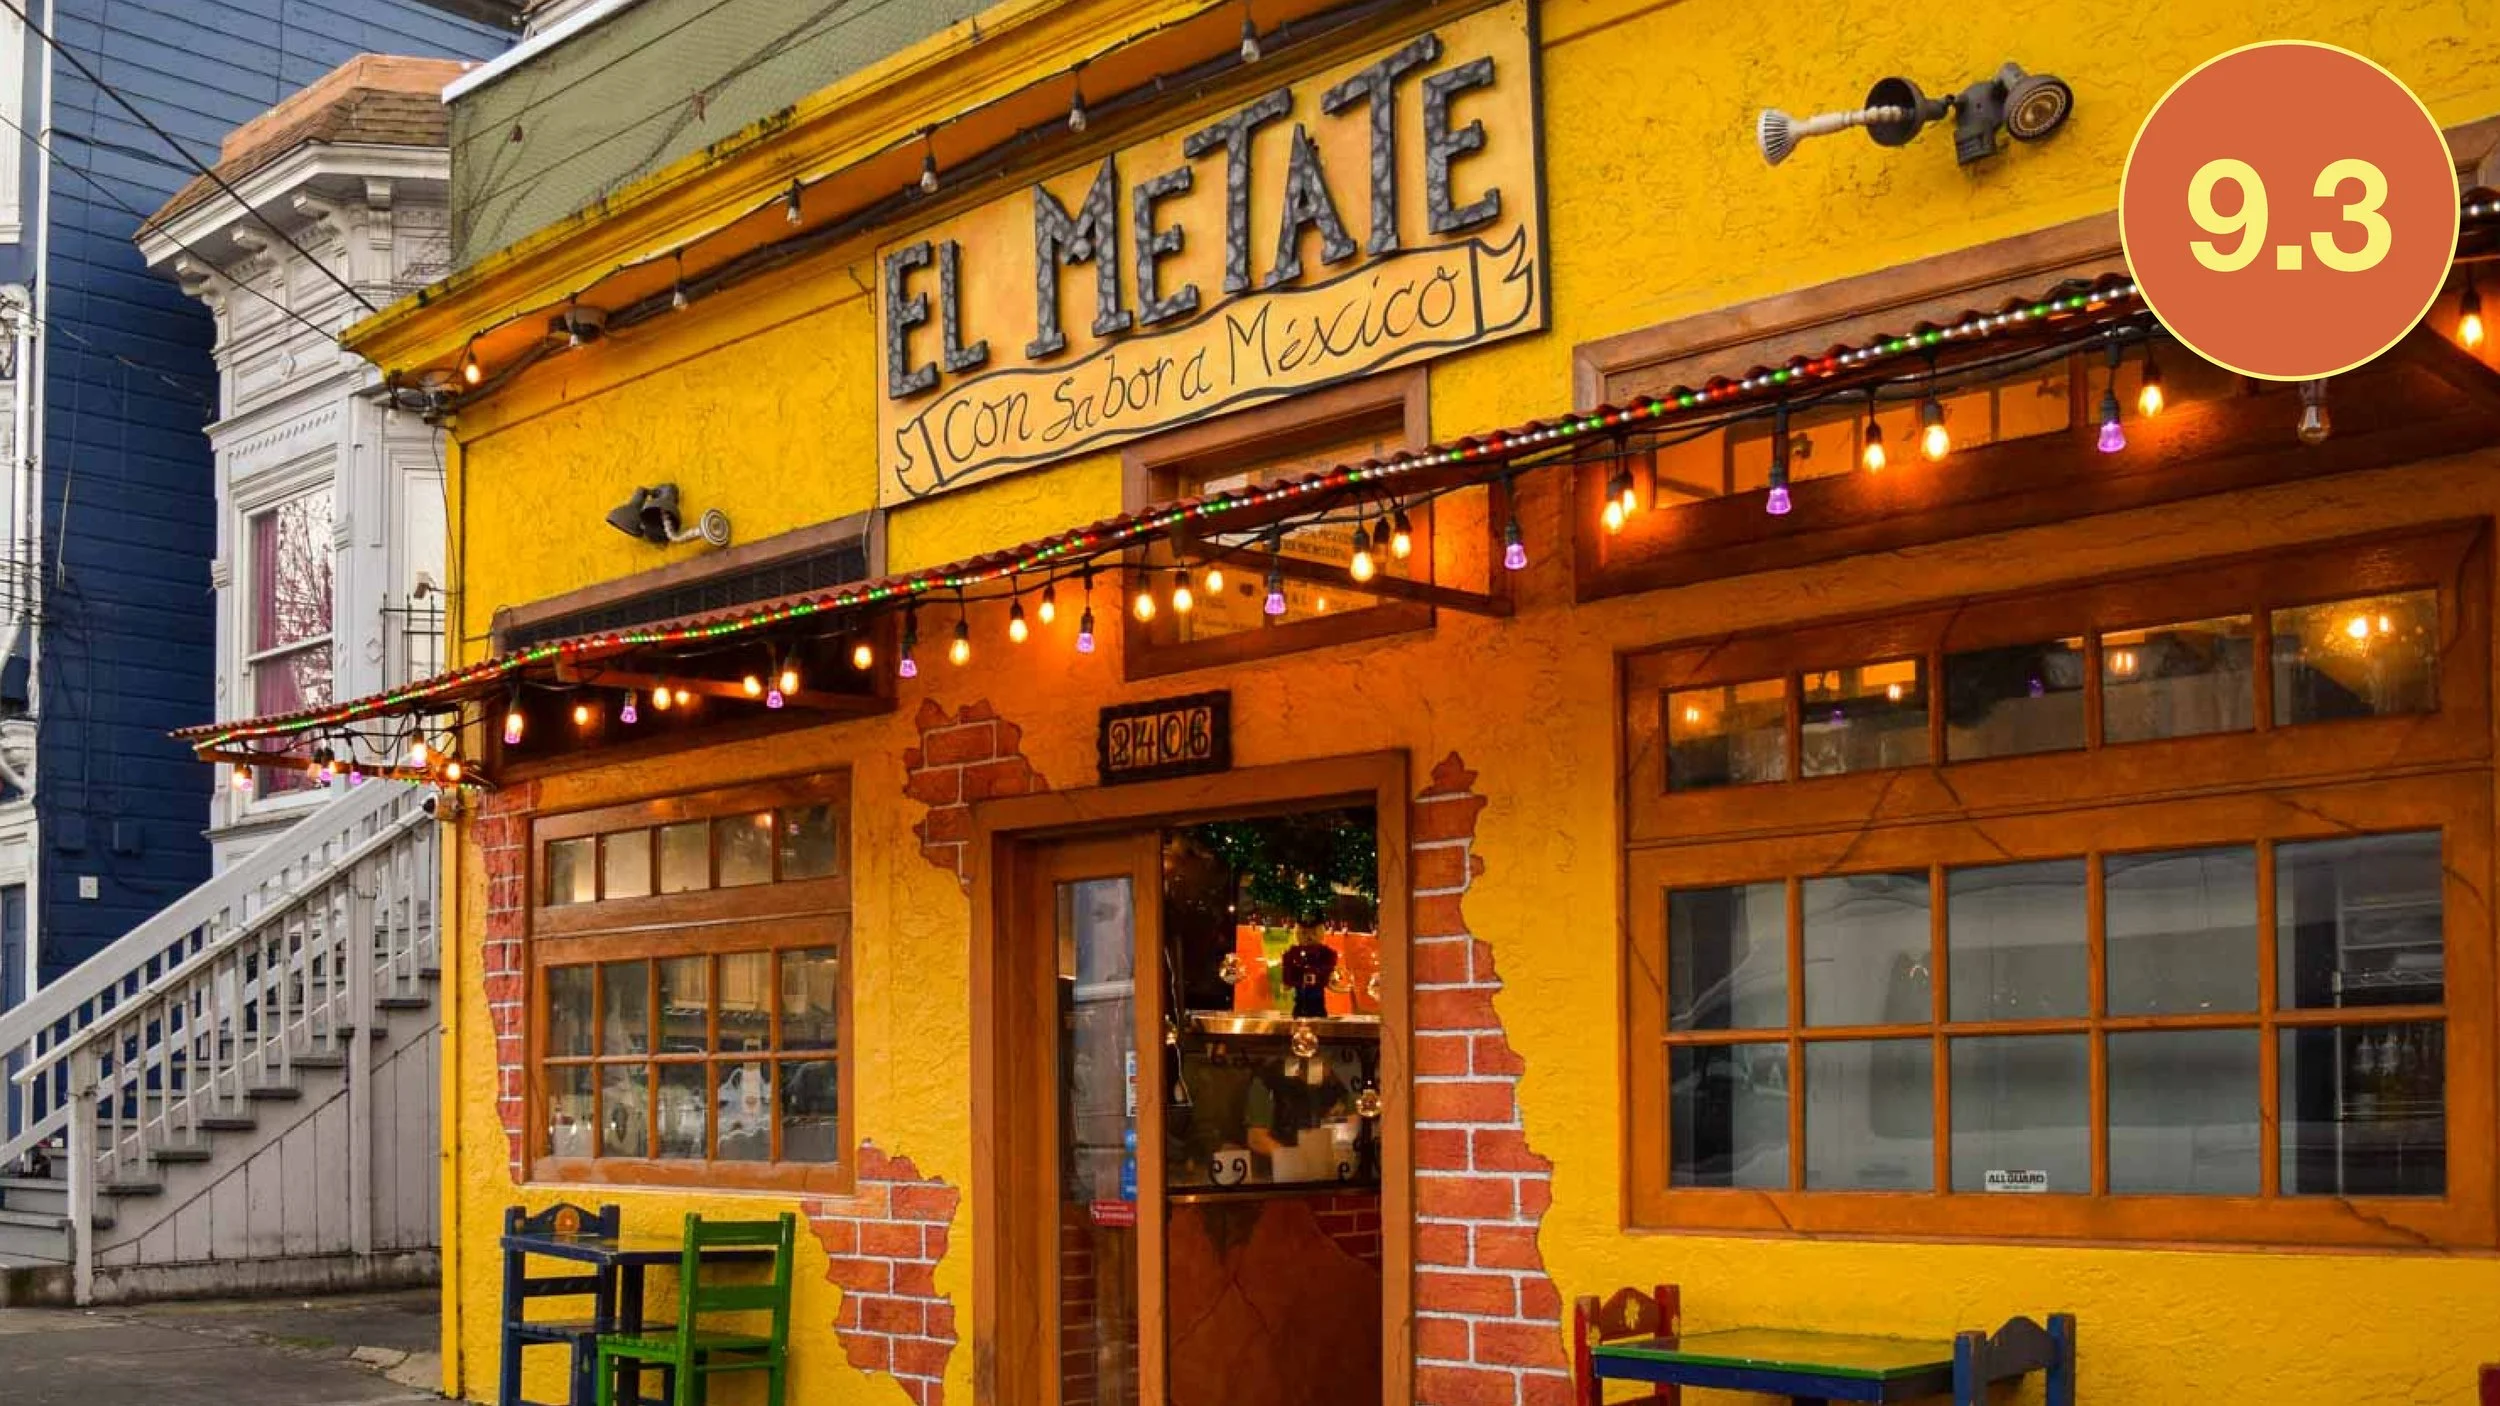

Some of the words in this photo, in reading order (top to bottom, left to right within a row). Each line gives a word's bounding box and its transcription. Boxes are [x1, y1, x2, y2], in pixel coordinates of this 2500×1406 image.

[885, 239, 989, 400] EL
[942, 390, 1033, 464] Con
[1225, 266, 1461, 387] México
[1110, 709, 1209, 766] 2406
